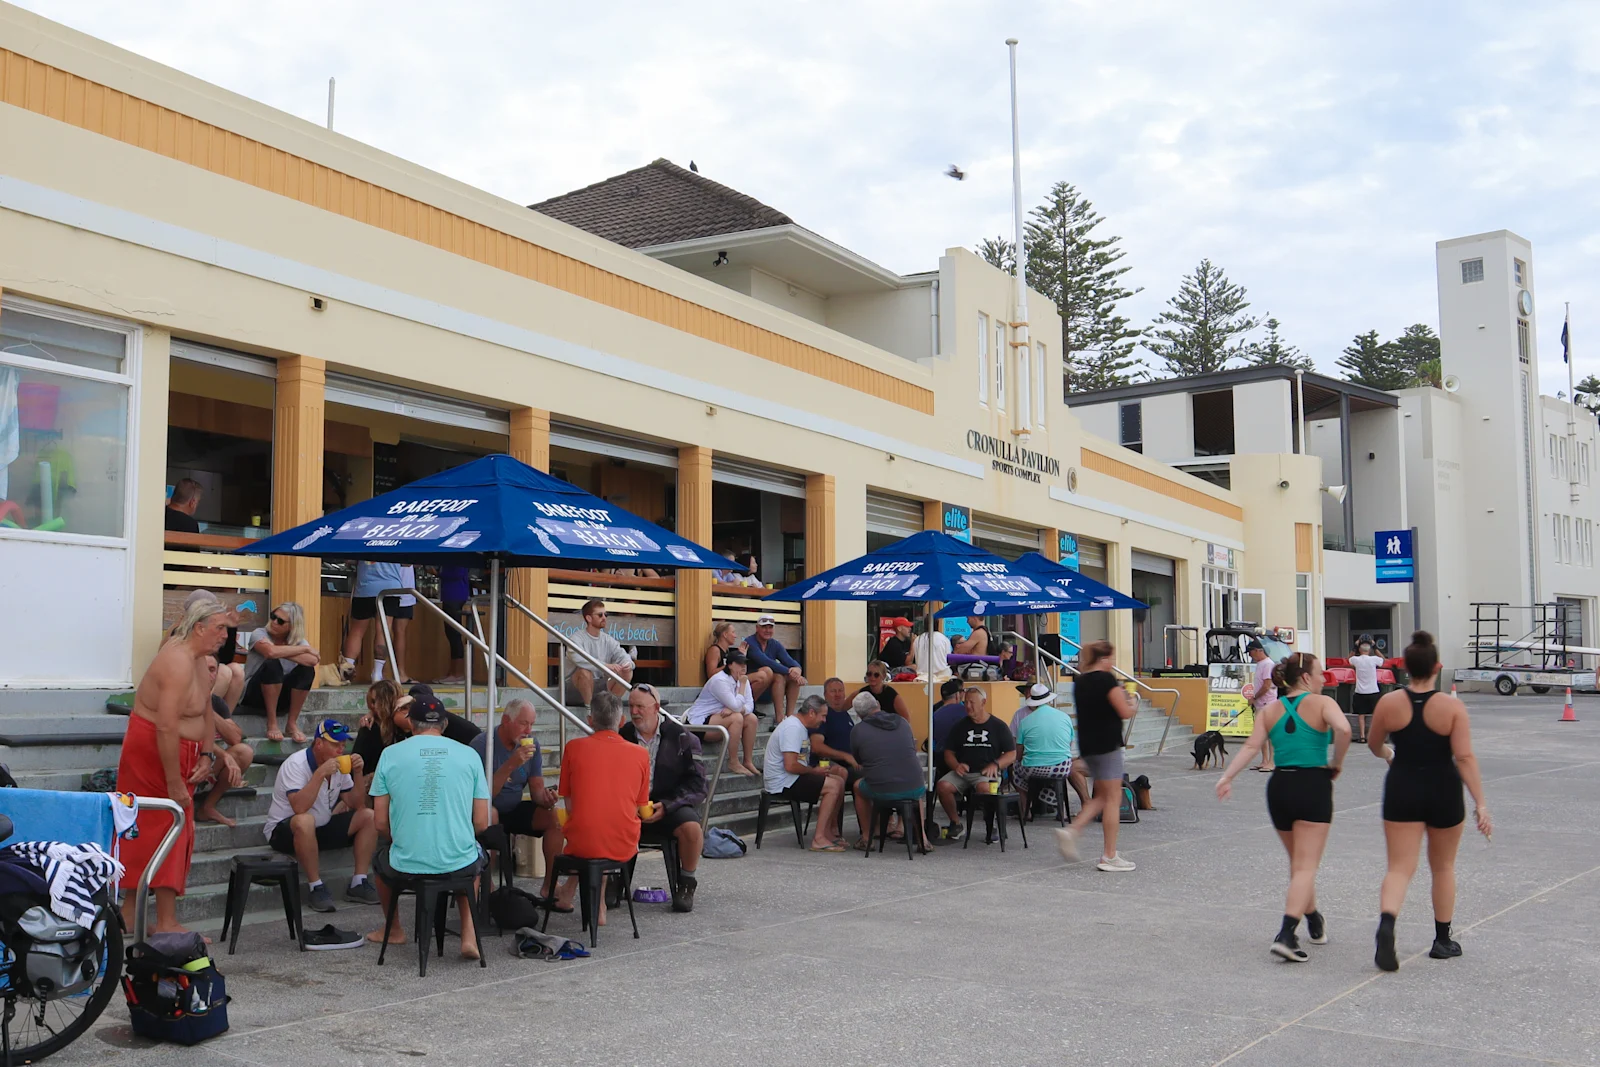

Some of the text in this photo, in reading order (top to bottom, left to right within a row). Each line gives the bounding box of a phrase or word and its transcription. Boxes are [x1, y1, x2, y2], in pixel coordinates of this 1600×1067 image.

[966, 429, 1060, 477] CRONULLA PAVILION
[992, 460, 1041, 484] SPORTS COMPLEX
[387, 500, 478, 514] BAREFOOT
[532, 501, 612, 523] BAREFOOT
[400, 513, 438, 523] on the
[573, 519, 608, 531] on the
[944, 507, 967, 530] elite
[362, 524, 440, 538] BEACH
[572, 529, 642, 550] BEACH
[1060, 534, 1077, 553] elite
[862, 562, 924, 573] BAREFOOT
[957, 562, 1009, 573] BAREFOOT
[849, 580, 900, 590] BEACH
[985, 580, 1030, 591] BEACH
[609, 622, 625, 641] the
[627, 622, 659, 642] beach
[1211, 676, 1239, 689] elite
